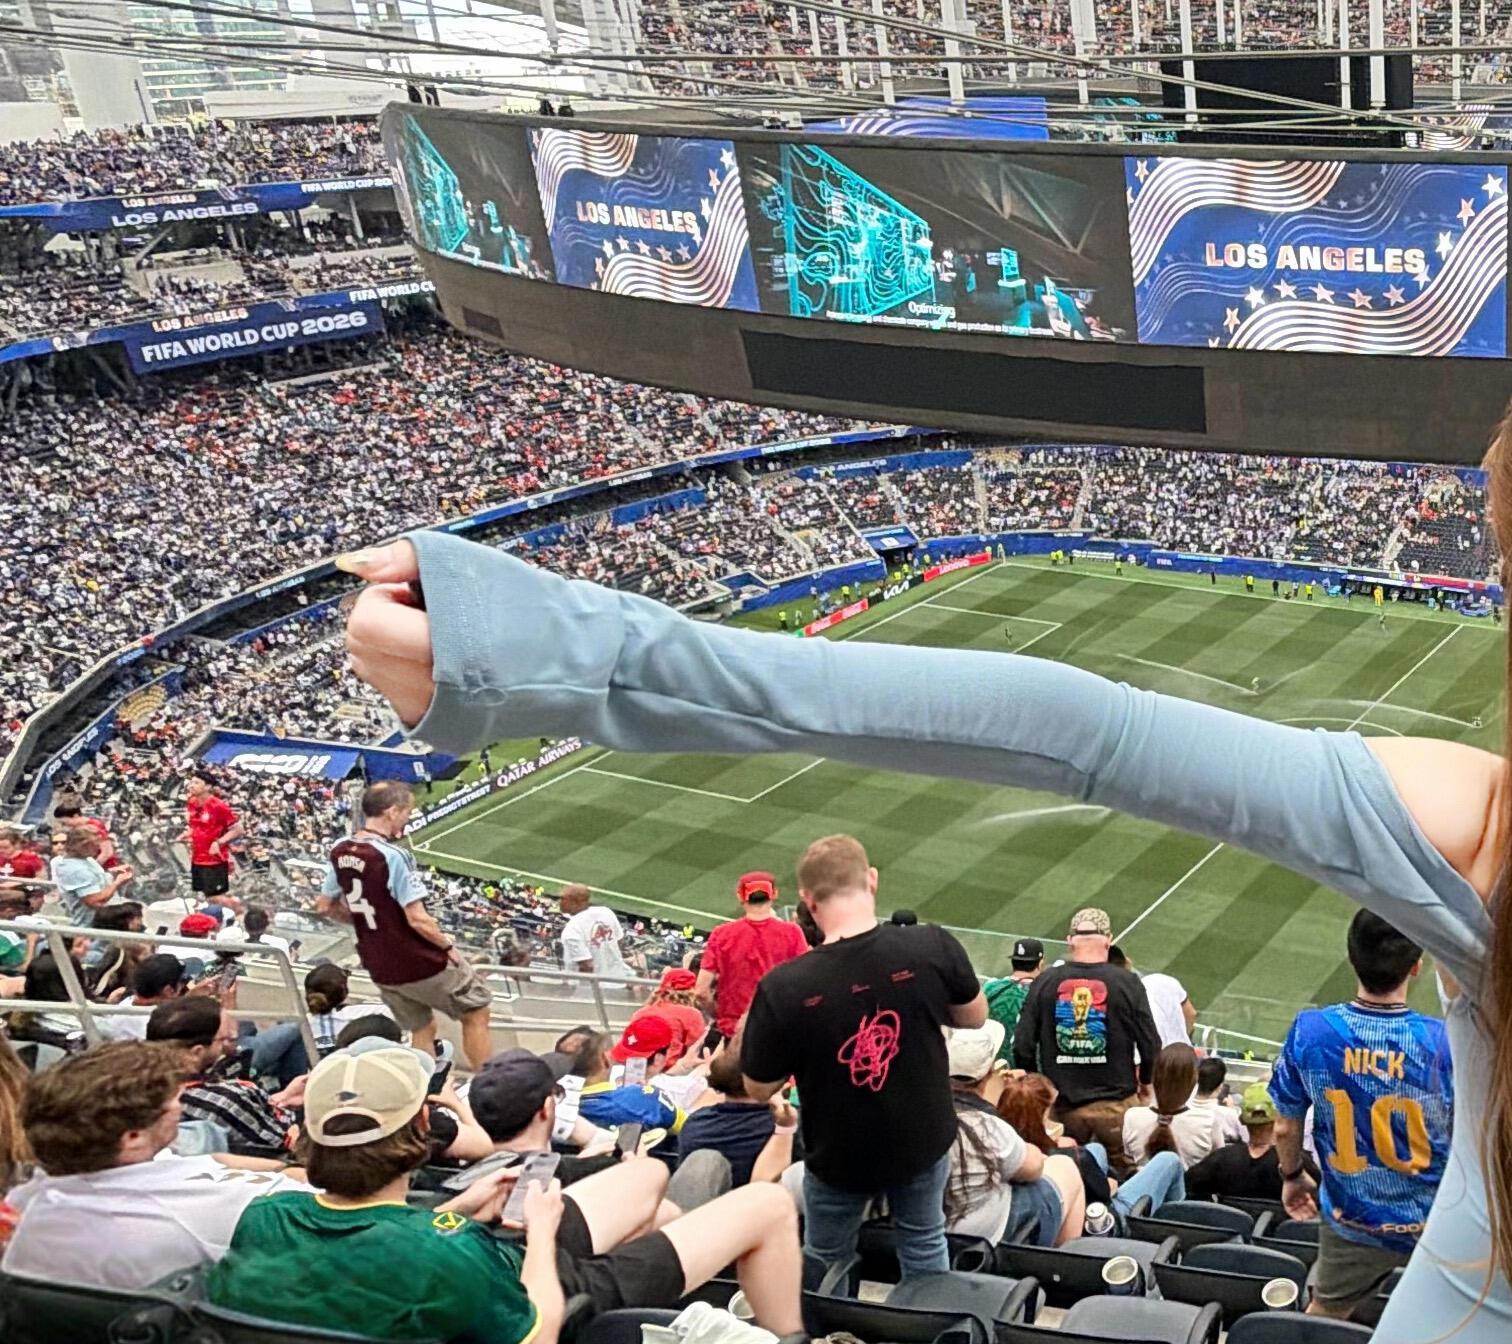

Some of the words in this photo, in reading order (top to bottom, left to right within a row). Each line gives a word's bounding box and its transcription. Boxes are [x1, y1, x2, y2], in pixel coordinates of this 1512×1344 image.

[112, 210, 158, 227] LOS
[161, 203, 259, 222] ANGELES
[122, 197, 146, 208] LOS
[147, 193, 197, 206] ANGELES
[575, 200, 611, 225] LOS
[613, 204, 698, 233] ANGELES
[1205, 242, 1268, 269] LOS
[1275, 244, 1426, 273] ANGELES
[349, 289, 376, 303] FIFA
[377, 283, 419, 299] WORLD
[141, 341, 187, 362] FIFA
[187, 327, 260, 354] WORLD
[262, 323, 300, 343] CUP
[302, 311, 367, 335] 2026
[152, 319, 181, 333] LOS
[183, 308, 249, 327] ANGELES
[496, 762, 537, 787] QATAR
[538, 739, 582, 769] AIRWAYS
[403, 811, 428, 835] ADI
[345, 877, 378, 930] 4
[1343, 1046, 1406, 1080] NICK
[1324, 1088, 1432, 1176] 10
